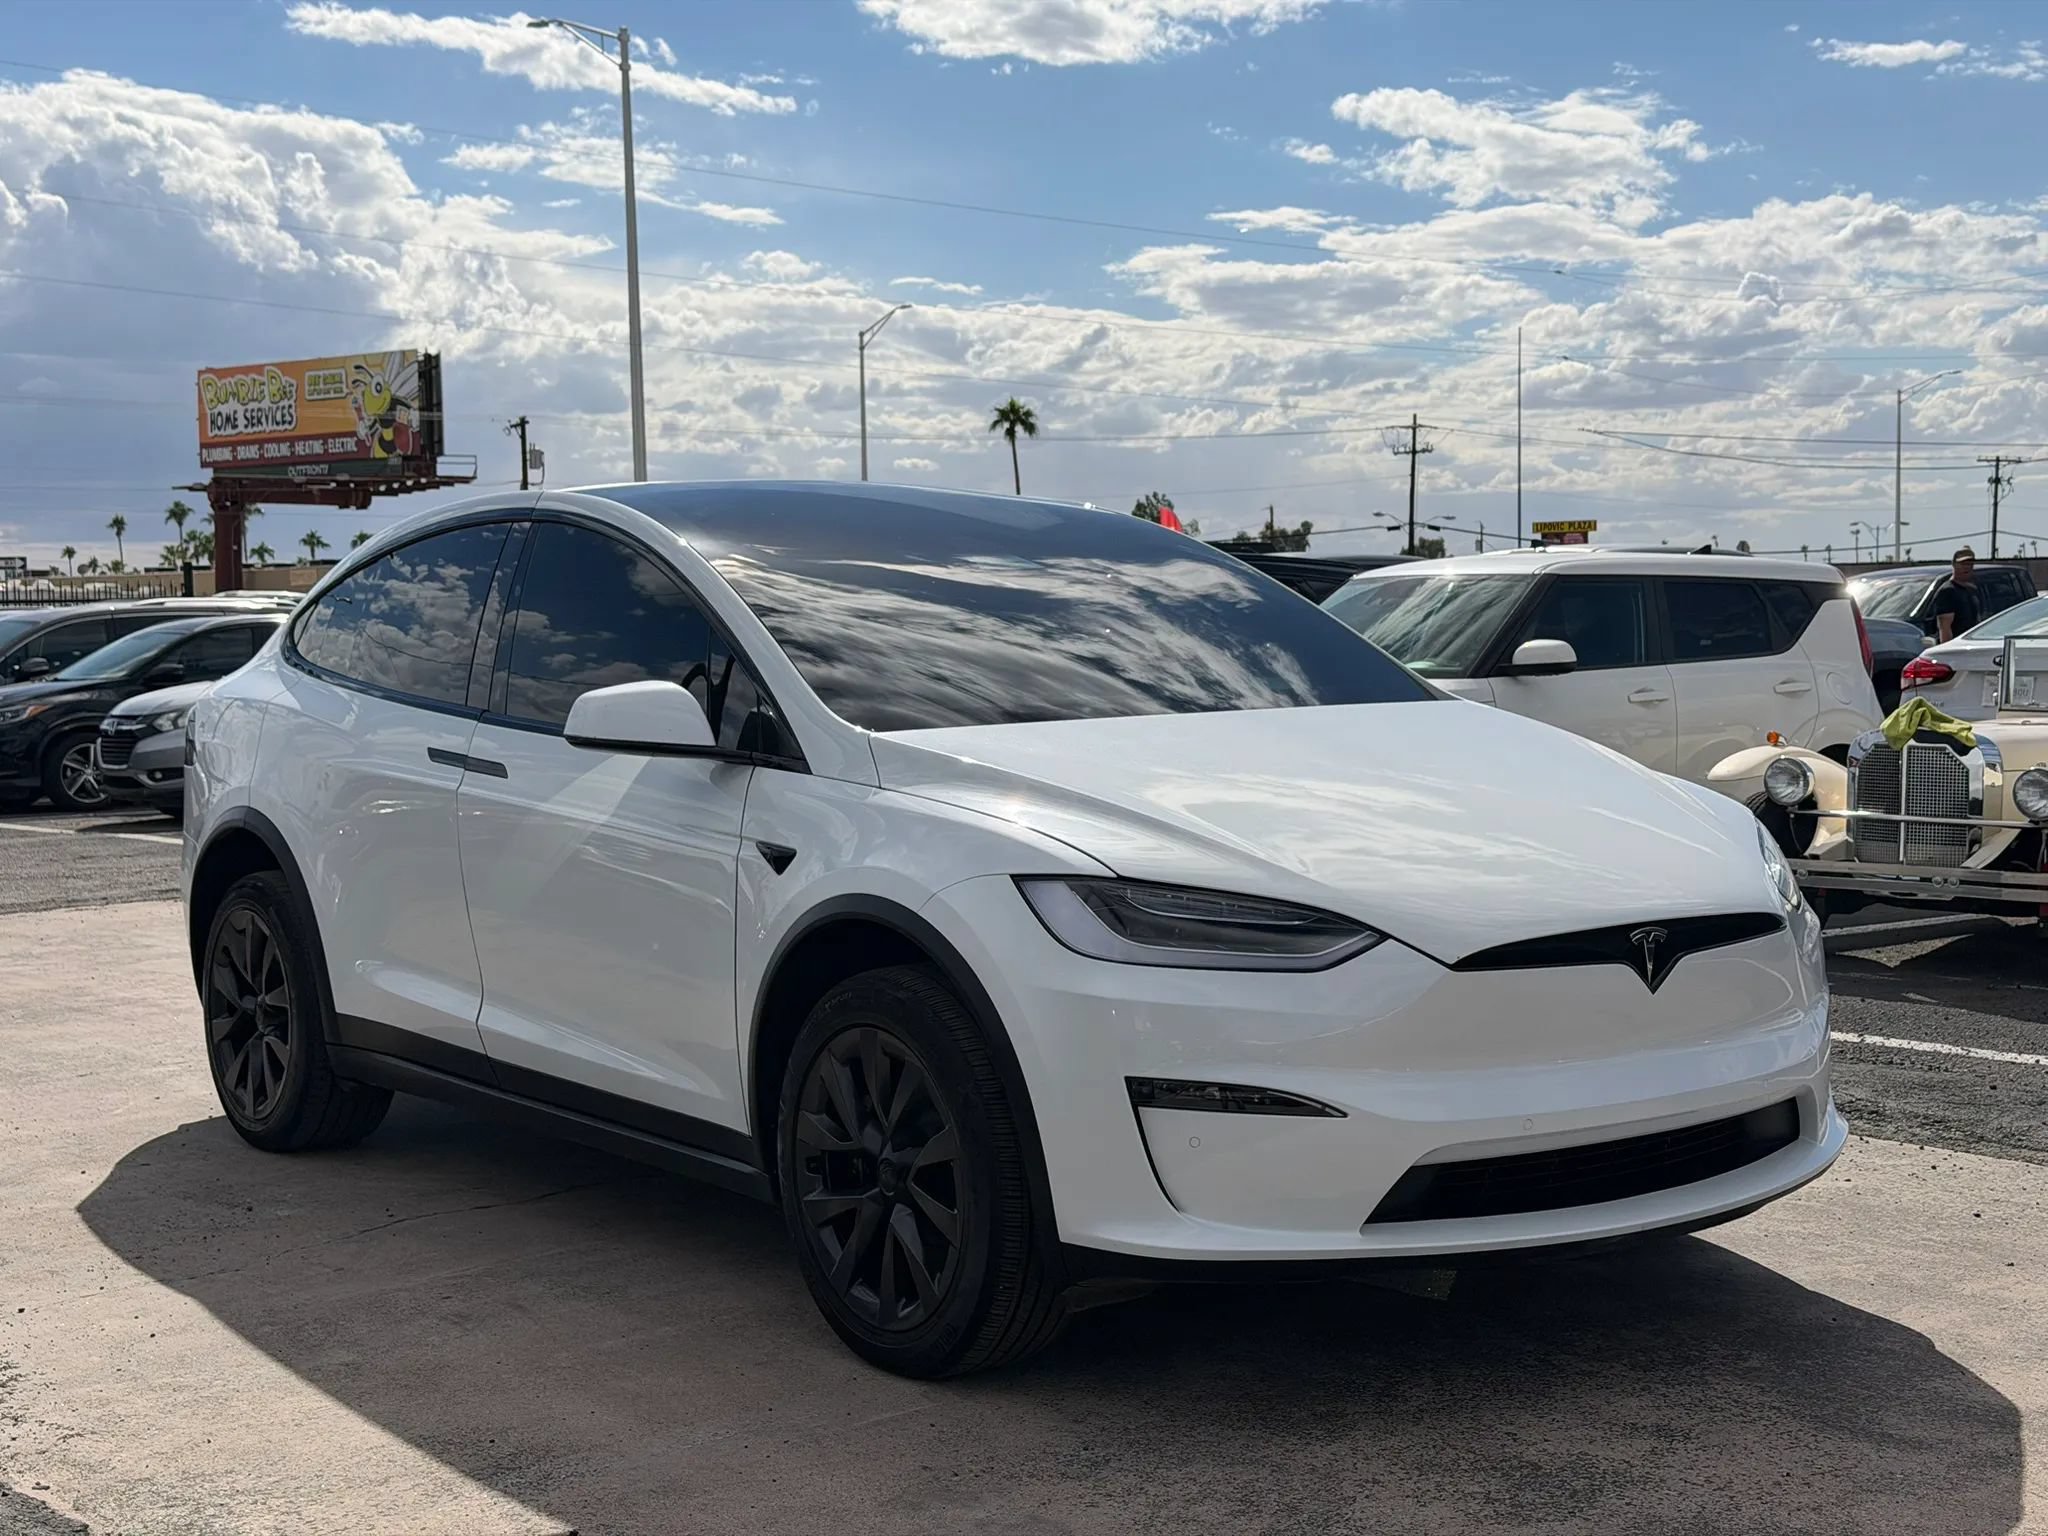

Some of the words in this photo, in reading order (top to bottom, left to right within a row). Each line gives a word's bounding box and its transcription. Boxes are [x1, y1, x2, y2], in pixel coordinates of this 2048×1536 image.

[202, 377, 265, 410] BUMBLE
[266, 367, 295, 404] BEE
[210, 410, 239, 432] HOME
[243, 404, 293, 429] SERVICES
[202, 446, 233, 463] PLUMBING
[237, 444, 260, 460] DRAINS
[263, 442, 291, 458] COOLING
[295, 439, 325, 456] HEATING
[328, 436, 358, 453] ELECTRIC
[1537, 522, 1565, 532] LIPOVIC
[1569, 521, 1592, 530] PLAZA
